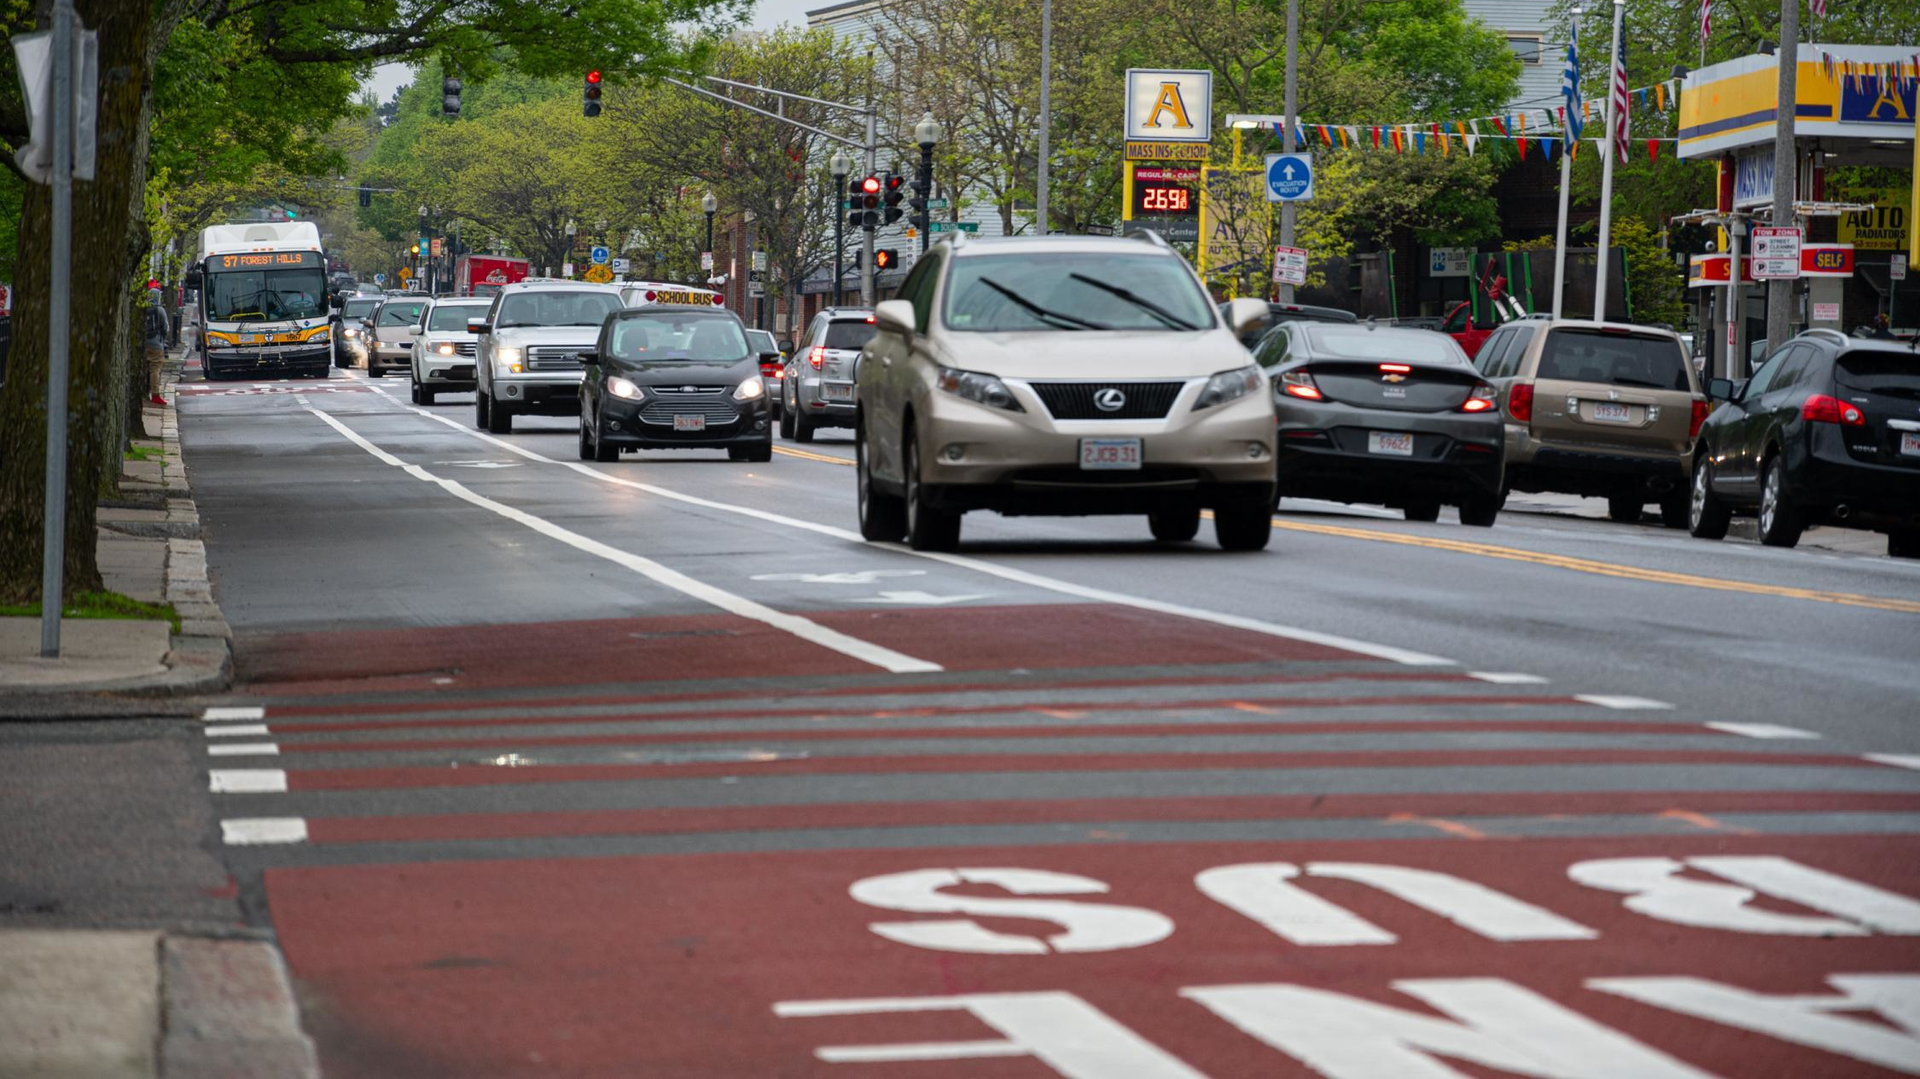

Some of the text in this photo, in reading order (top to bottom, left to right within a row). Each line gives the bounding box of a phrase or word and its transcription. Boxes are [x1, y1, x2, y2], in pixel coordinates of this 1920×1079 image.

[1142, 81, 1194, 129] A
[1129, 144, 1153, 157] MASS
[1272, 180, 1307, 188] EVACUATION
[1280, 186, 1300, 194] ROUTE
[1846, 206, 1904, 228] AUTO
[1169, 227, 1198, 236] Center
[1855, 228, 1906, 239] RADIATORS
[223, 254, 302, 268] 37 FOREST HILLS
[1816, 253, 1843, 268] SELF
[657, 290, 712, 305] SCHOOL BUS
[849, 853, 1920, 953] BUS
[773, 973, 1920, 1079] ANE
